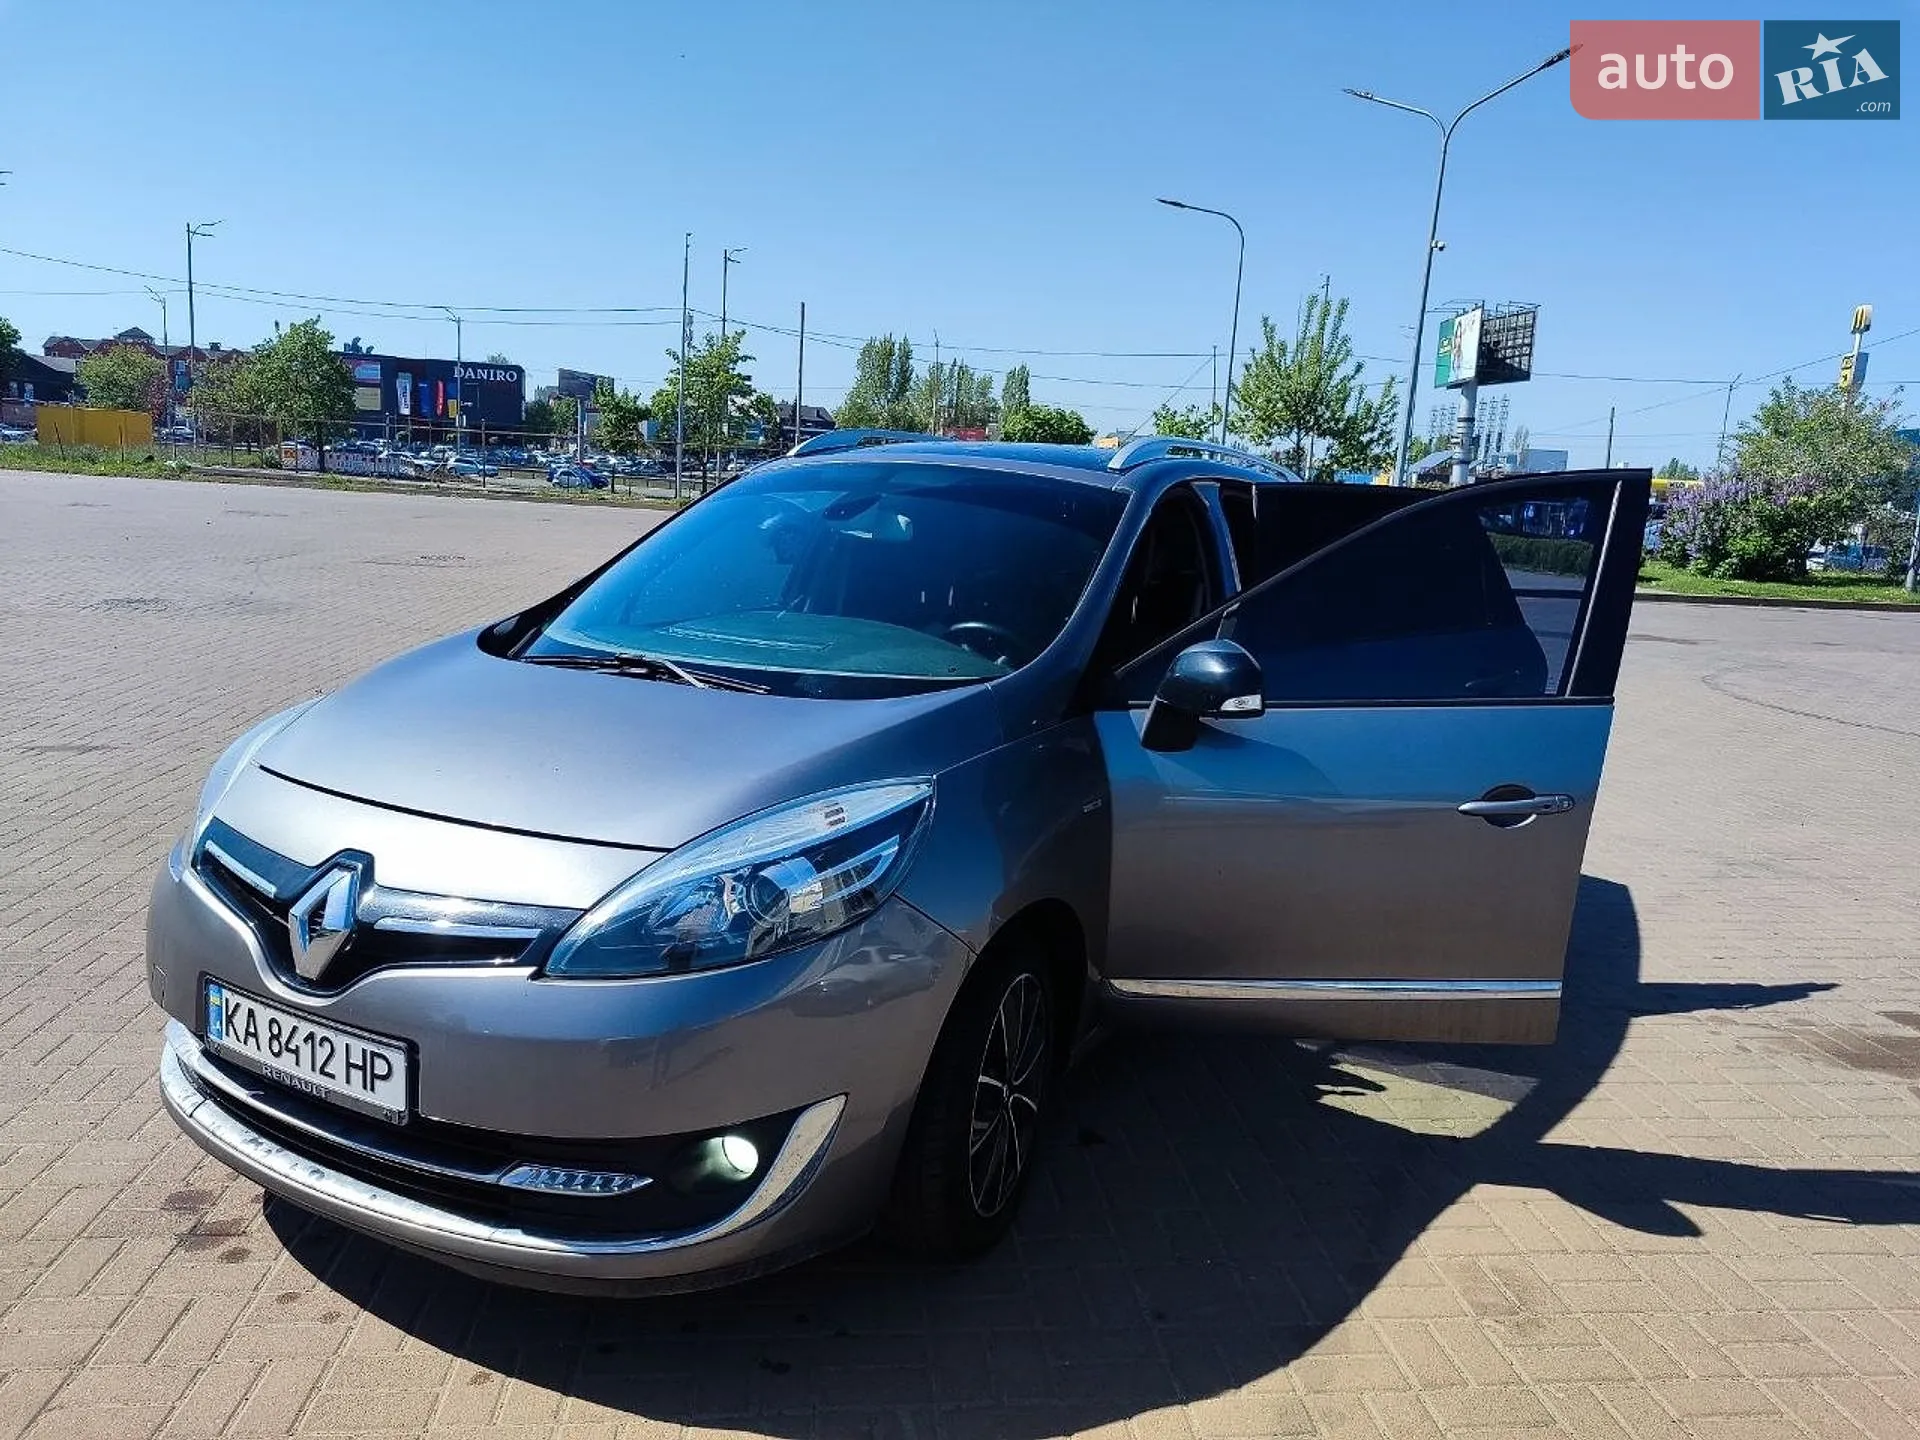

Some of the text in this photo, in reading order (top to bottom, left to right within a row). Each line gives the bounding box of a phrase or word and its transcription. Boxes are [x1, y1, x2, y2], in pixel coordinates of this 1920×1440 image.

[453, 366, 518, 382] DANIRO
[224, 997, 393, 1094] KA 8412 HP
[262, 1063, 331, 1099] RENAULT
